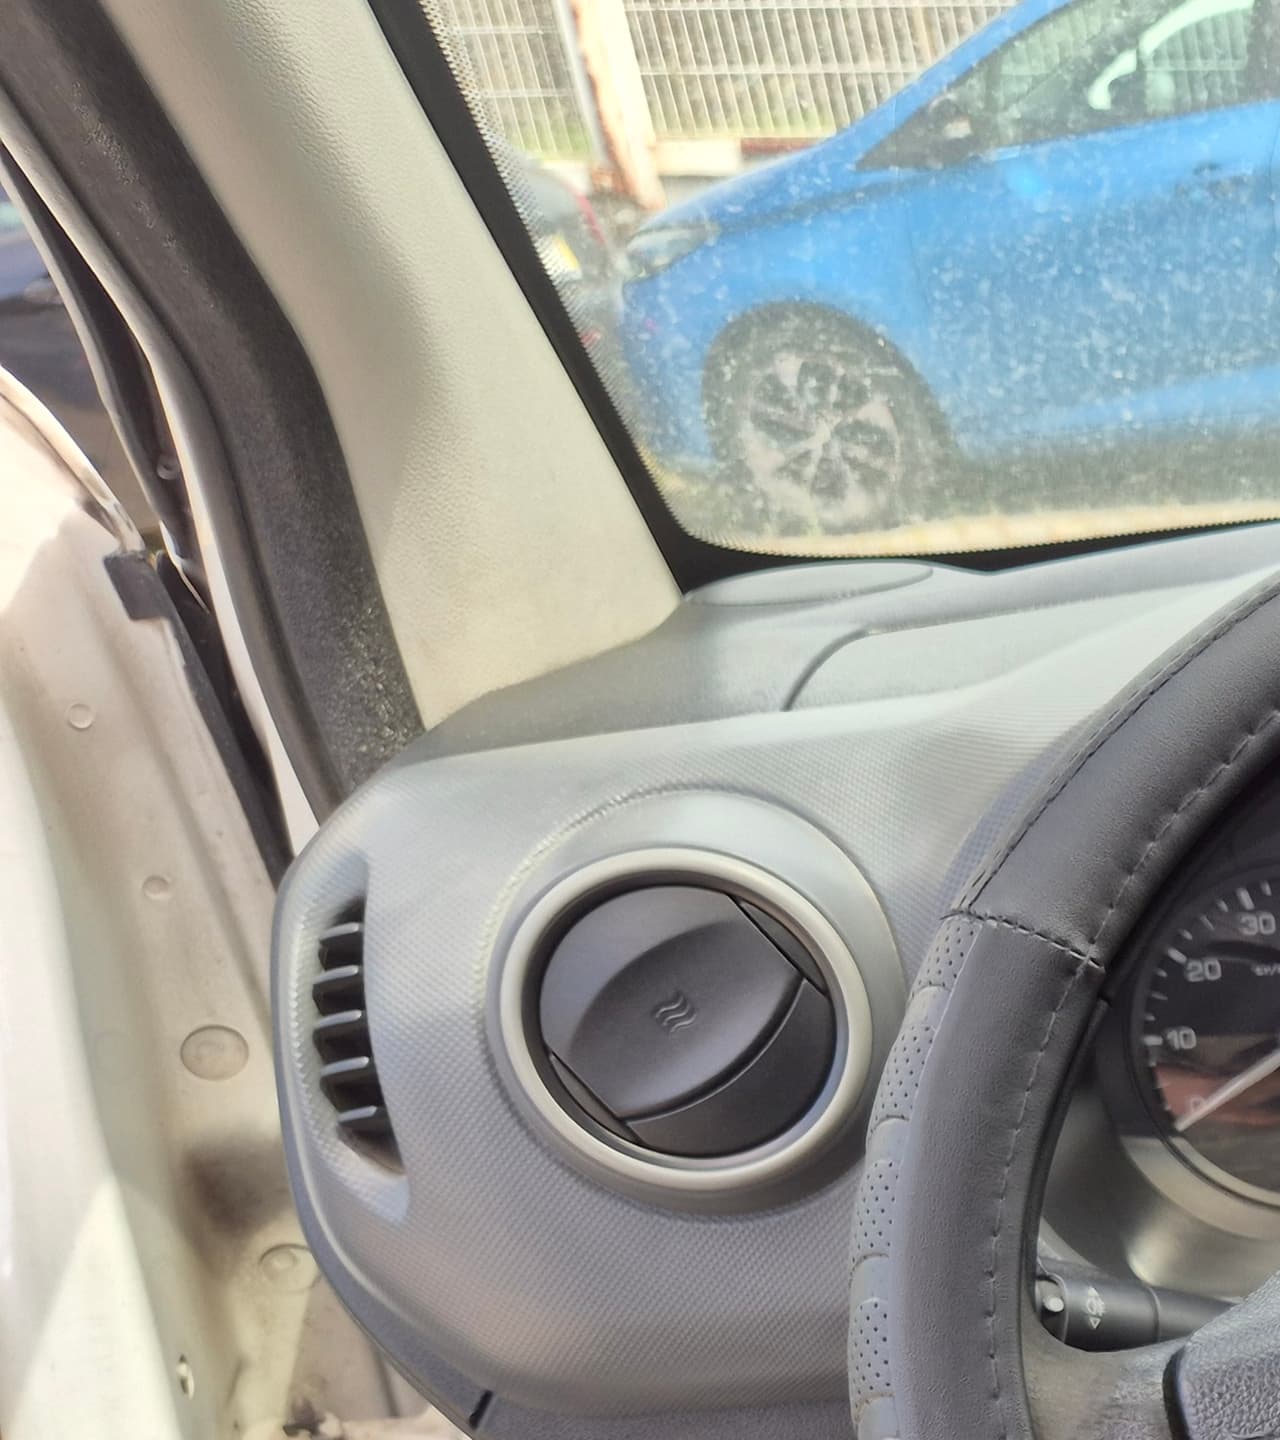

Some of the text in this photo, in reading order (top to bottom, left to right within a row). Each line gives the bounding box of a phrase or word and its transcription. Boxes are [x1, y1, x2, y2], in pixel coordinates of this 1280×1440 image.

[1239, 912, 1276, 936] 30
[1184, 957, 1222, 982] 20
[1166, 1026, 1197, 1050] 10
